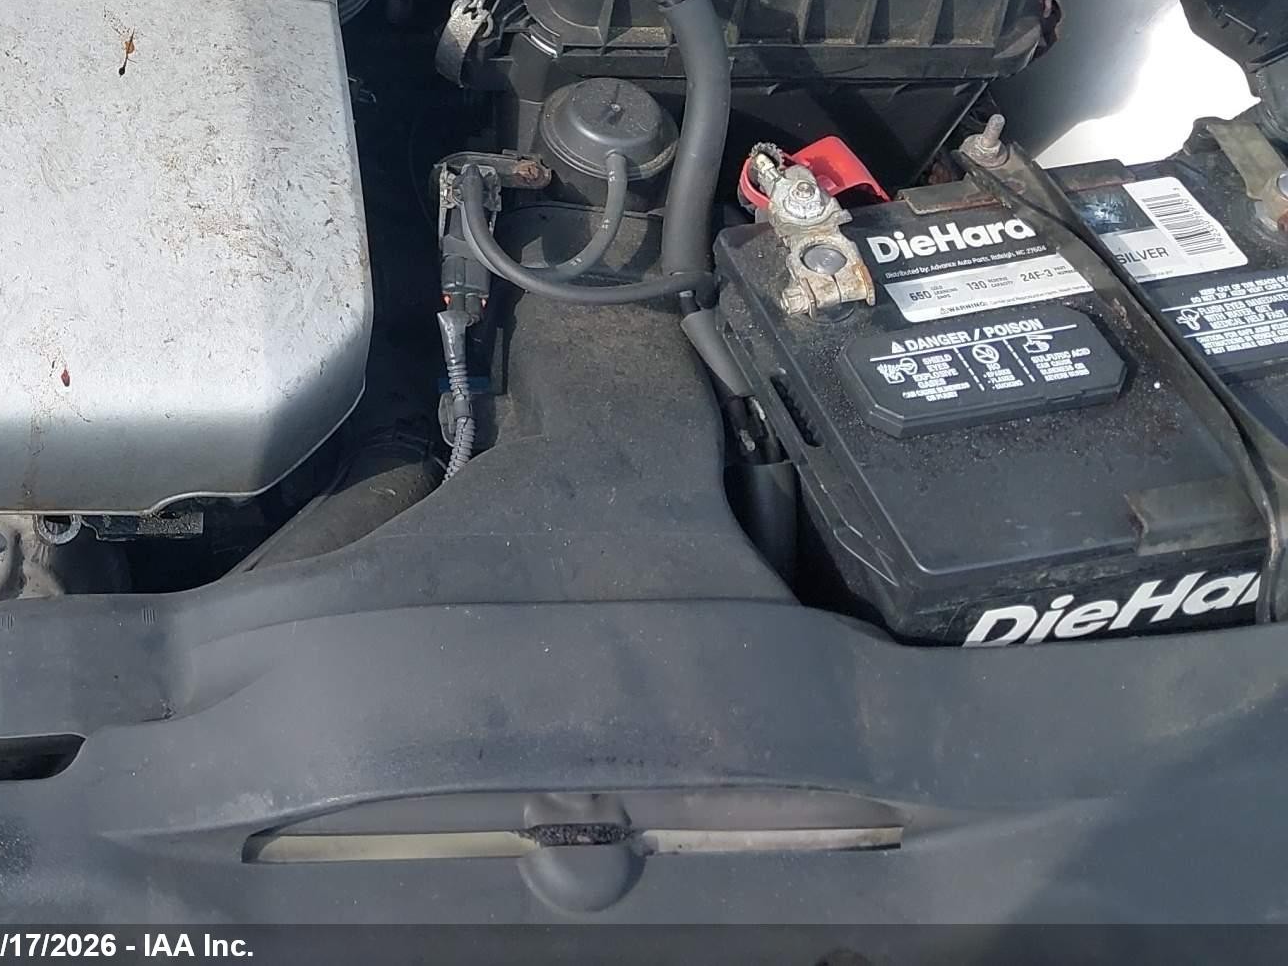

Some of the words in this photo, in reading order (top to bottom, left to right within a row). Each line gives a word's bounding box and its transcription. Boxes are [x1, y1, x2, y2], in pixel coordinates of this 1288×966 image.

[866, 216, 1037, 264] DieHard
[1114, 246, 1170, 265] SILVER
[966, 280, 988, 291] 130
[905, 331, 971, 351] DANGER
[983, 318, 1044, 338] POISON
